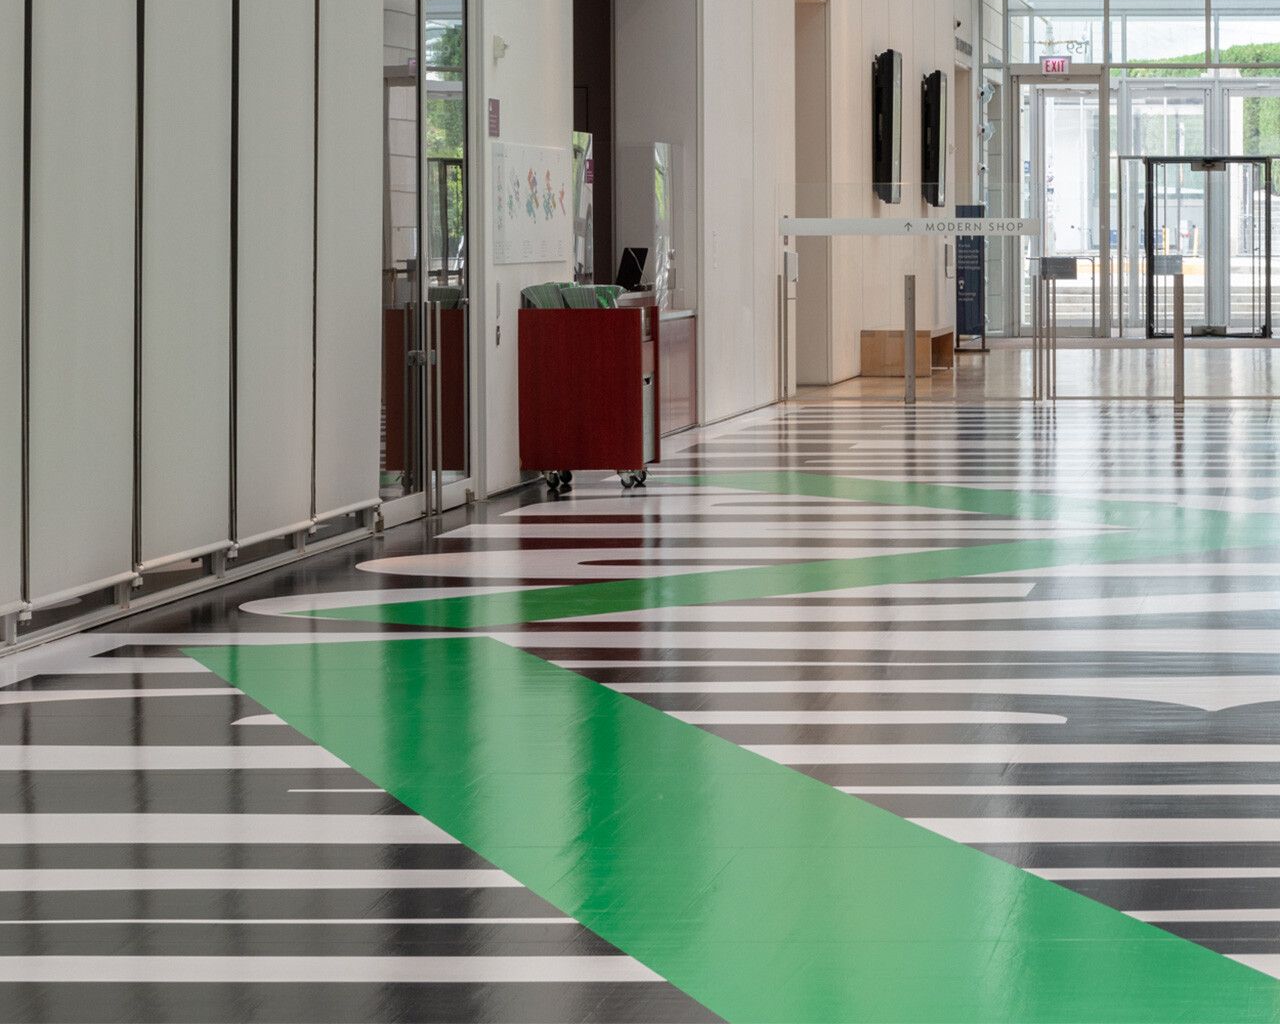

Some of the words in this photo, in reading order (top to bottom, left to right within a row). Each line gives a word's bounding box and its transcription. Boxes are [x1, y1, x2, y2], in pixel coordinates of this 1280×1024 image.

[1045, 60, 1065, 73] EXIT
[925, 222, 982, 232] MODERN
[988, 222, 1024, 232] SHOP
